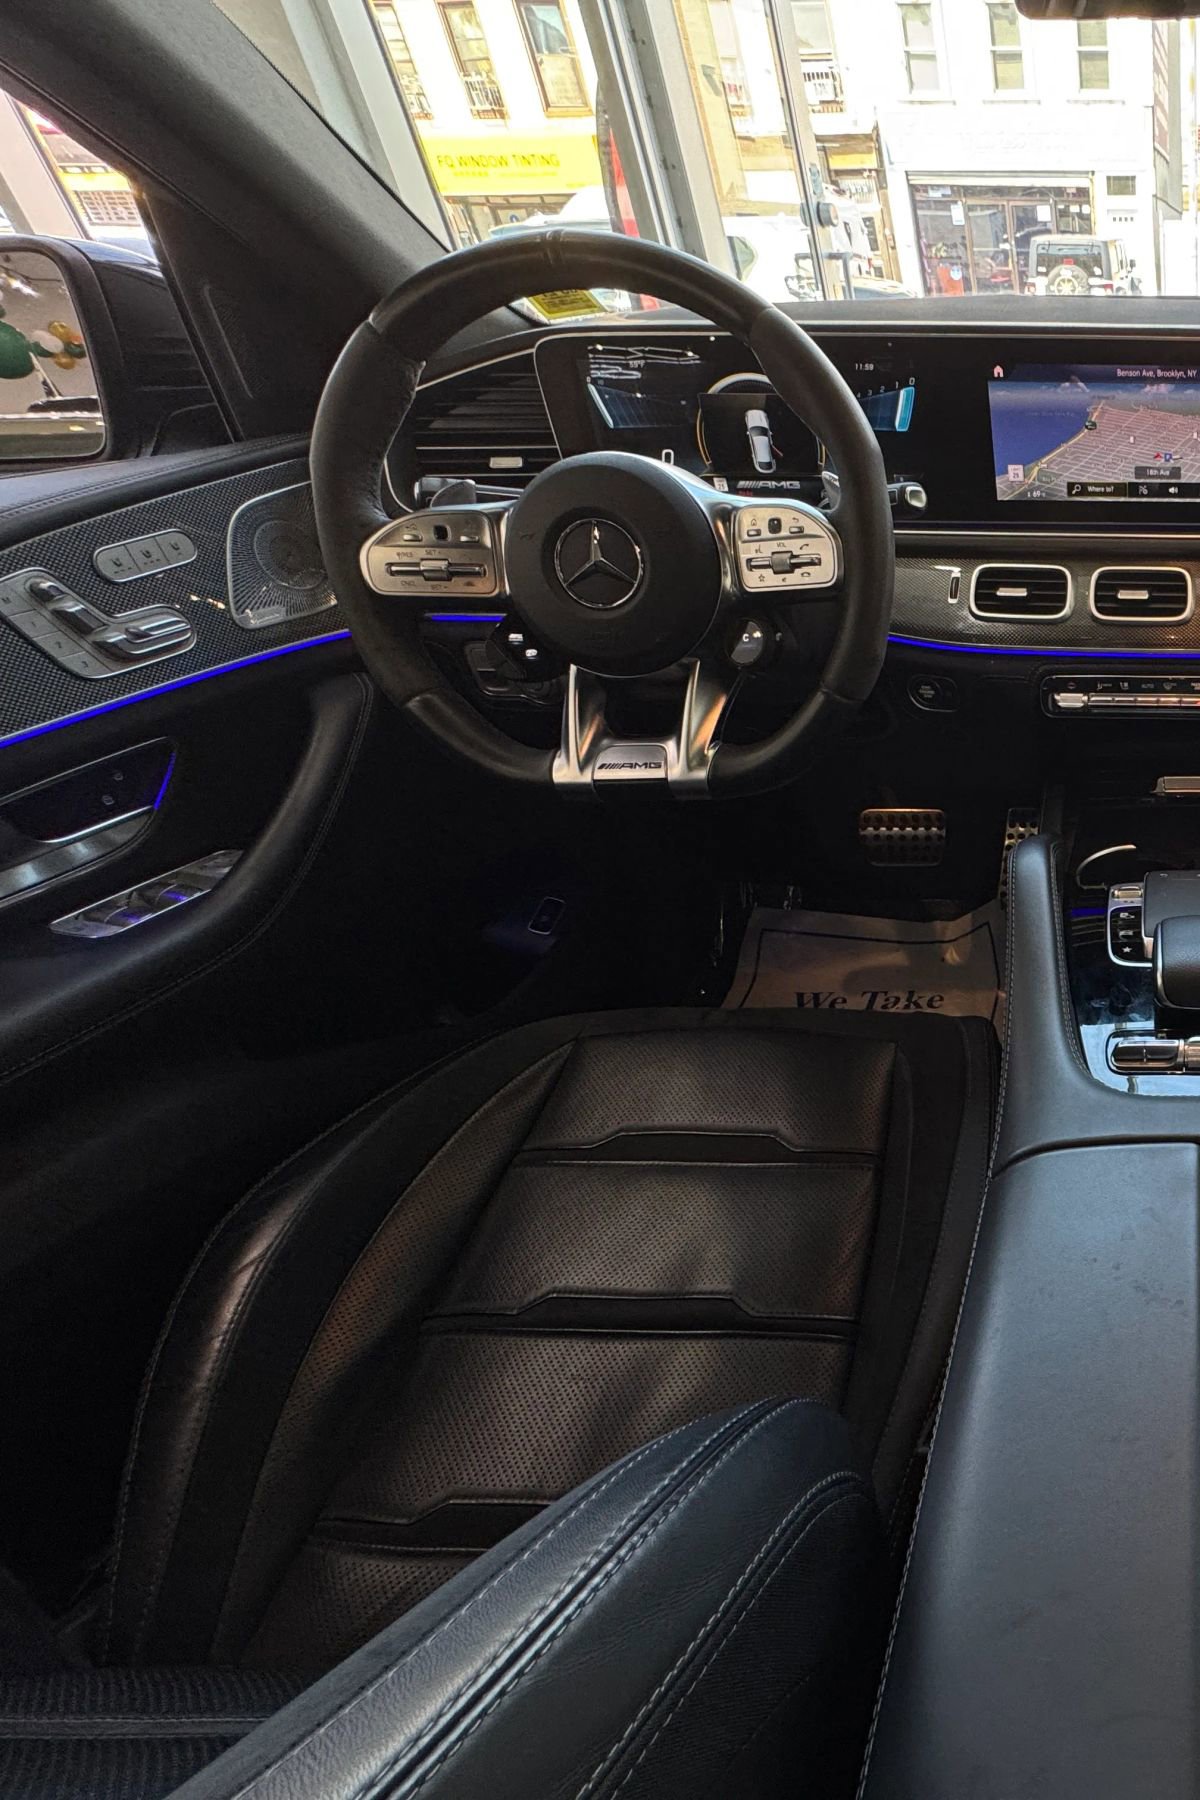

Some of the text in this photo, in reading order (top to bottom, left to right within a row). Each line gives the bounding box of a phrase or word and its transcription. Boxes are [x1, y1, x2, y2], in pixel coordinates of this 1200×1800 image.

[456, 154, 509, 168] WINDOW
[512, 153, 561, 168] TINTING
[855, 363, 874, 371] 11:59
[1116, 368, 1197, 379] Benson Ave, Brooklyn, NY
[757, 480, 801, 489] AMG
[1087, 485, 1105, 493] Where
[619, 761, 662, 770] AMG
[794, 990, 945, 1011] We Take
